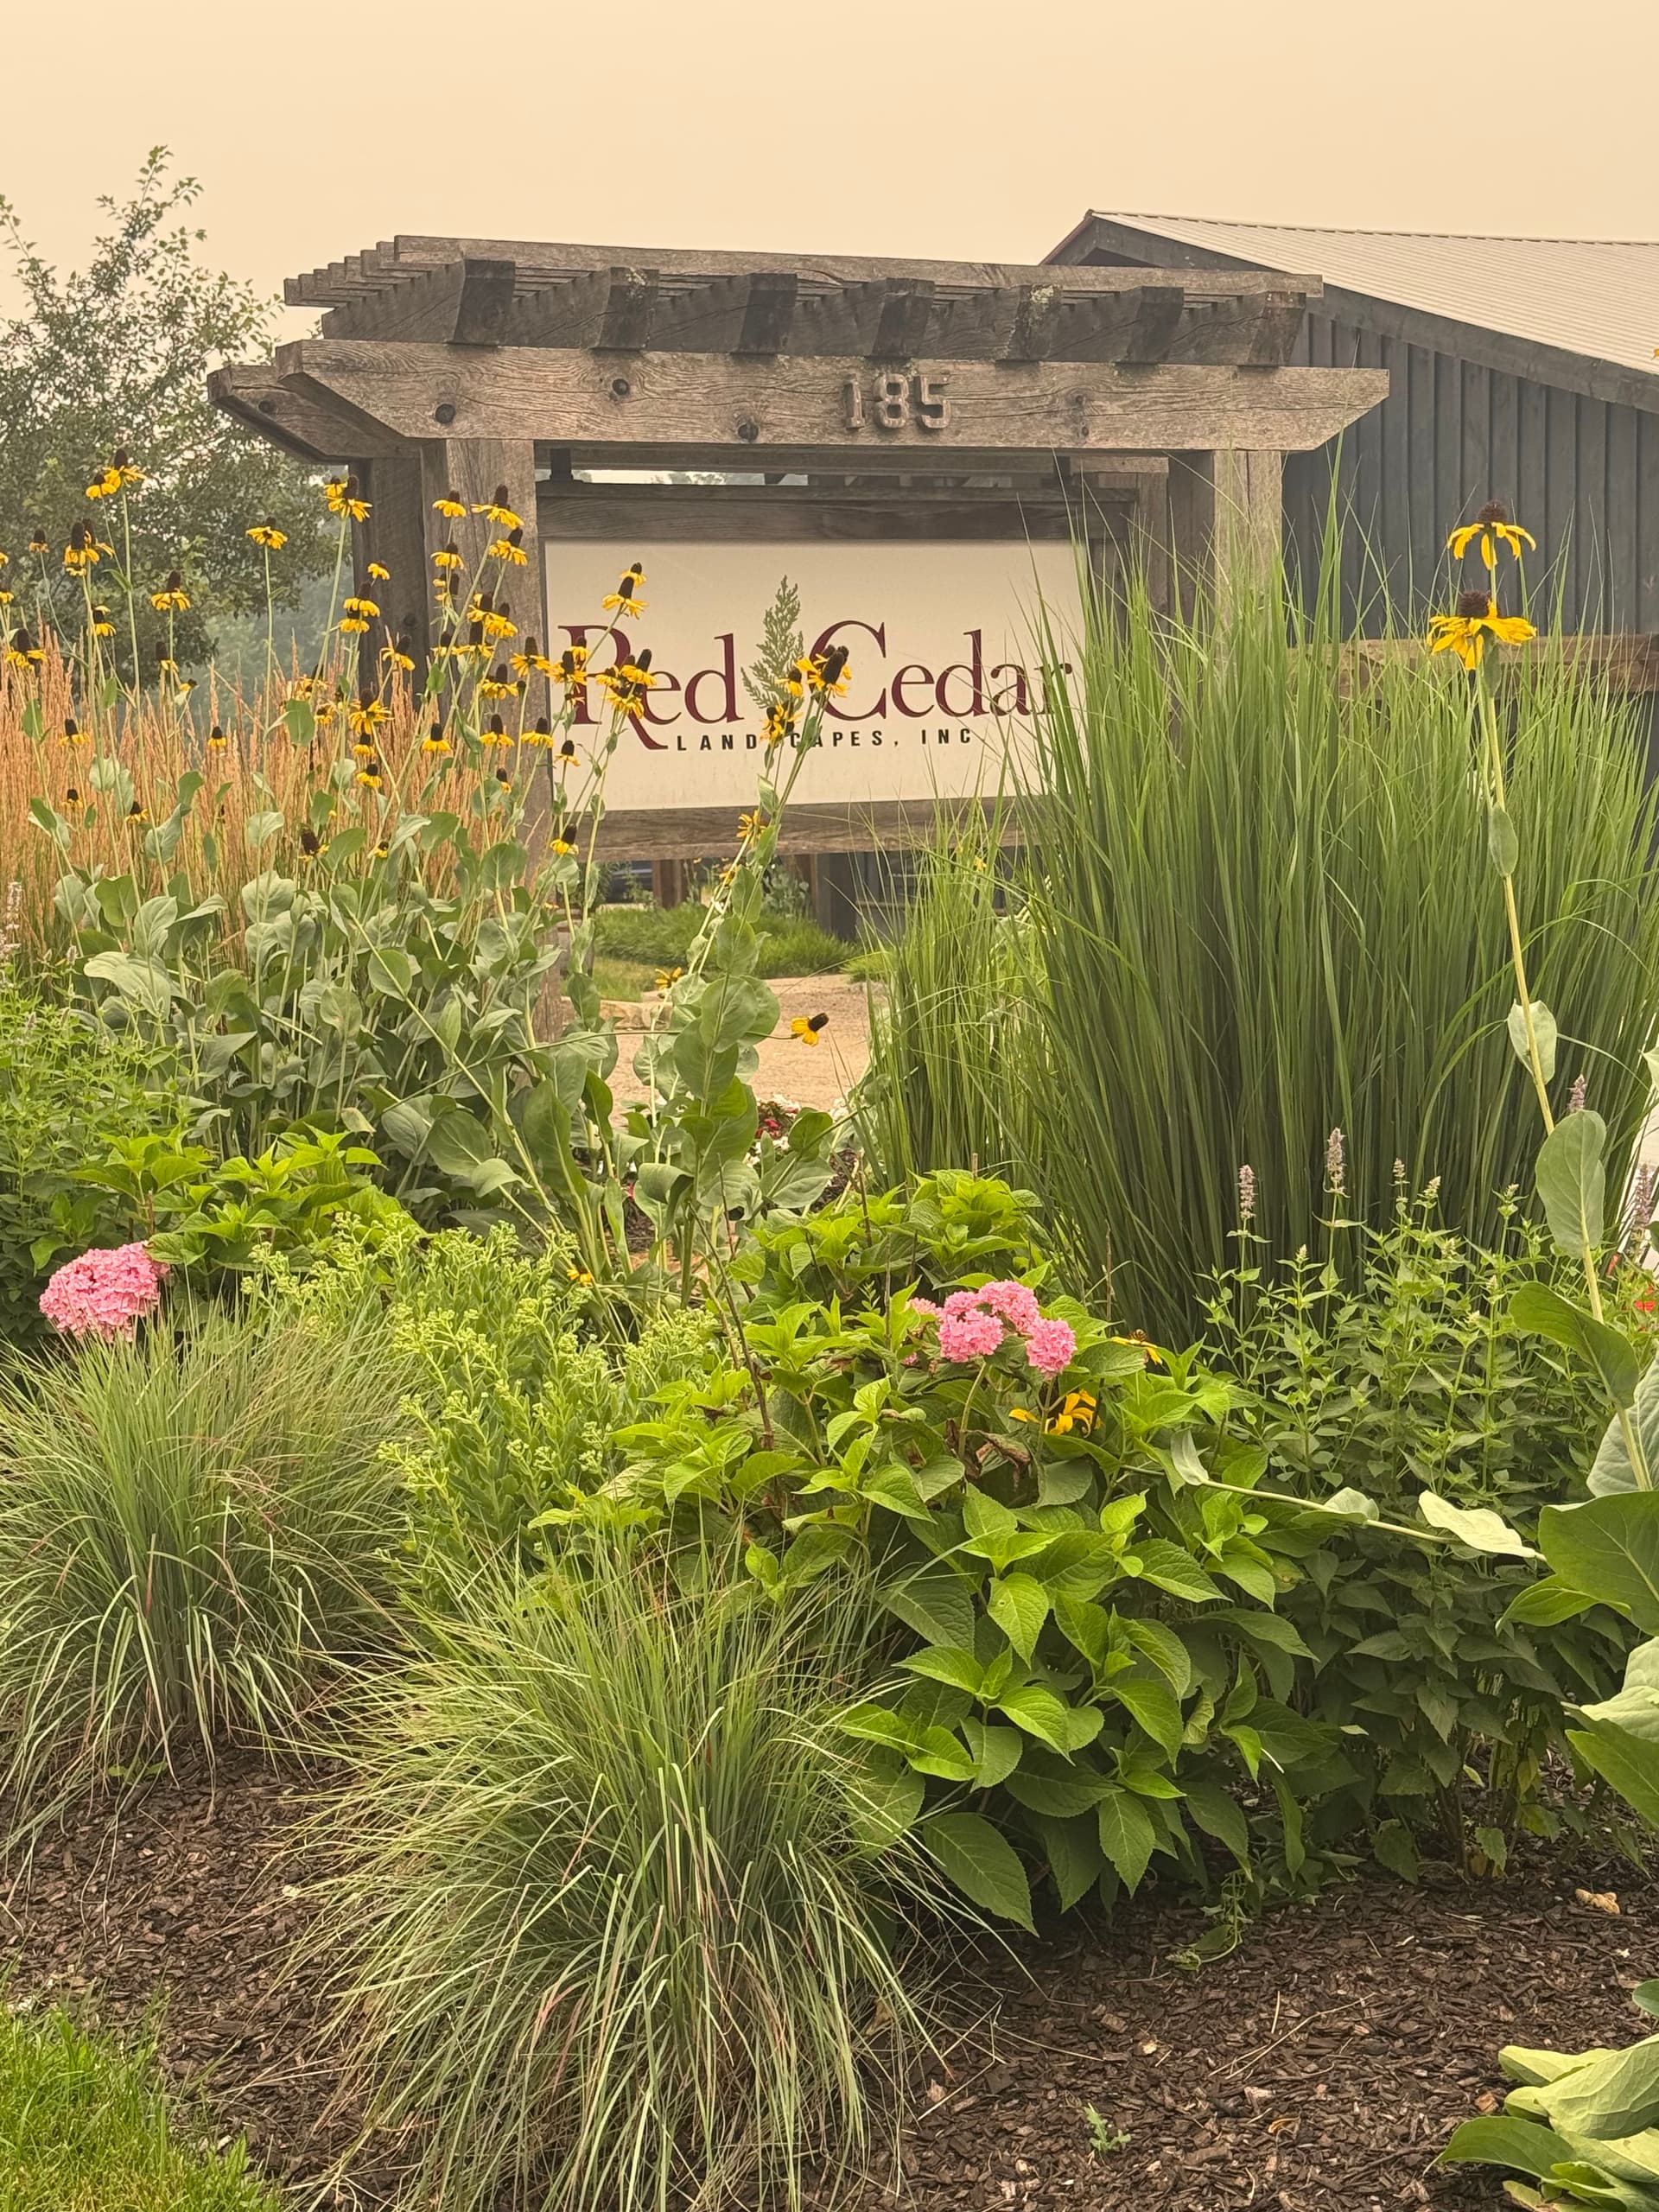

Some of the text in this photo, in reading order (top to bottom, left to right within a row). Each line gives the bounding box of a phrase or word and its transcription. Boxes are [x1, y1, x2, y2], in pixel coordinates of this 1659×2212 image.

[842, 373, 951, 429] 185
[557, 620, 1072, 750] Red Cedar
[677, 728, 970, 750] LANDCAPES, INC
